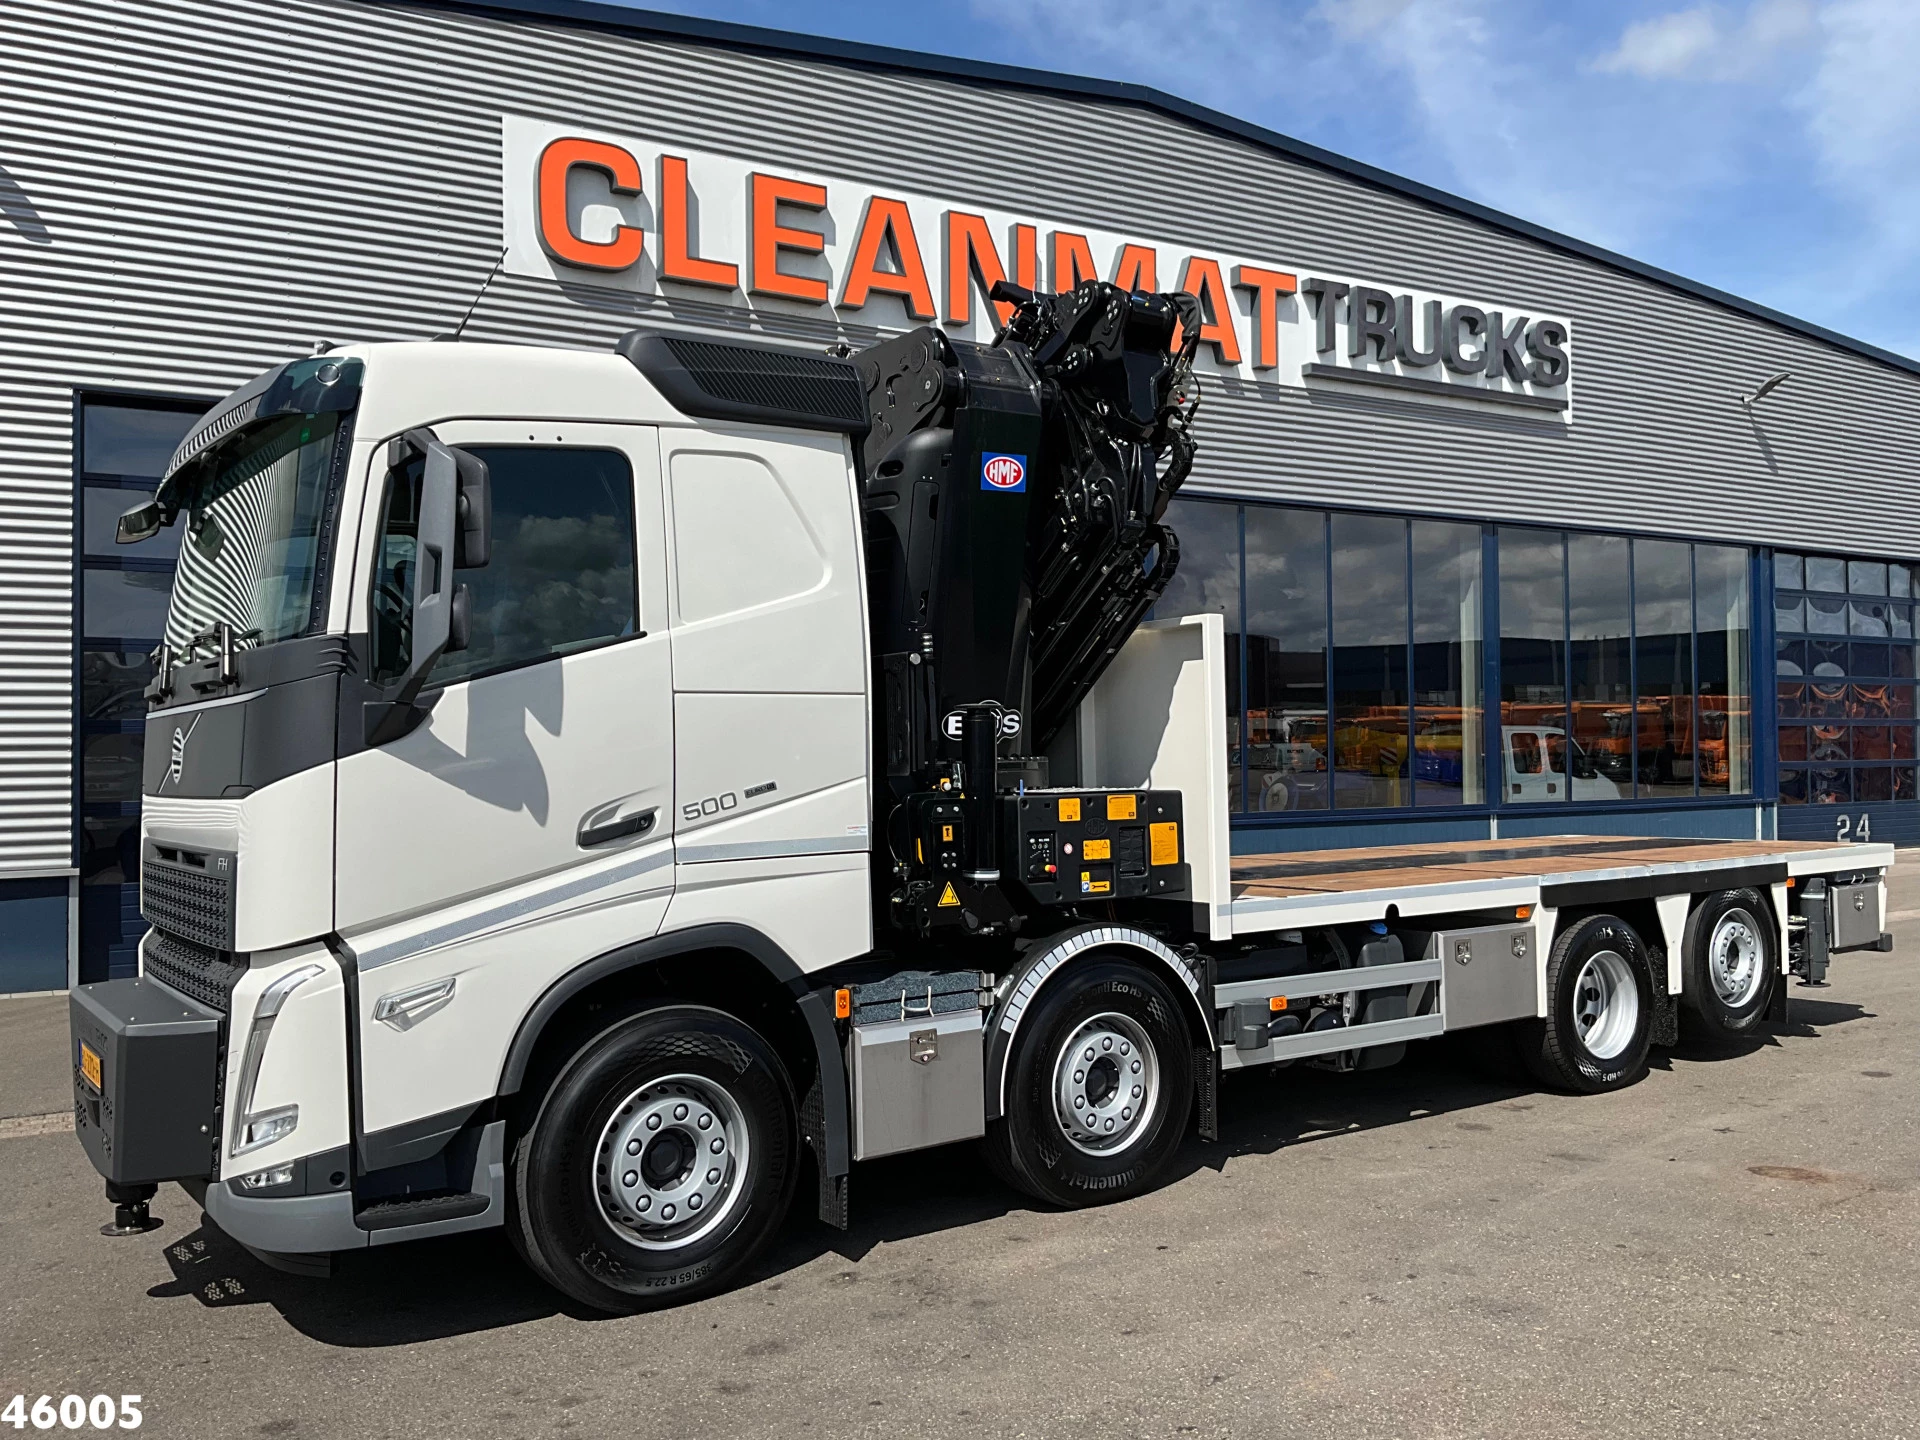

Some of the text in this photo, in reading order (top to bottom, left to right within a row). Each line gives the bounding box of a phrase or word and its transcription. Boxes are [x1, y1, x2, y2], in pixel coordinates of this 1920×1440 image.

[1302, 277, 1569, 389] TRUCKS
[988, 460, 1019, 484] HMF
[946, 713, 1021, 736] ES
[682, 792, 737, 821] 500
[1836, 813, 1871, 843] 24
[217, 857, 229, 871] FH
[1111, 981, 1129, 993] Eco
[669, 1276, 677, 1285] R
